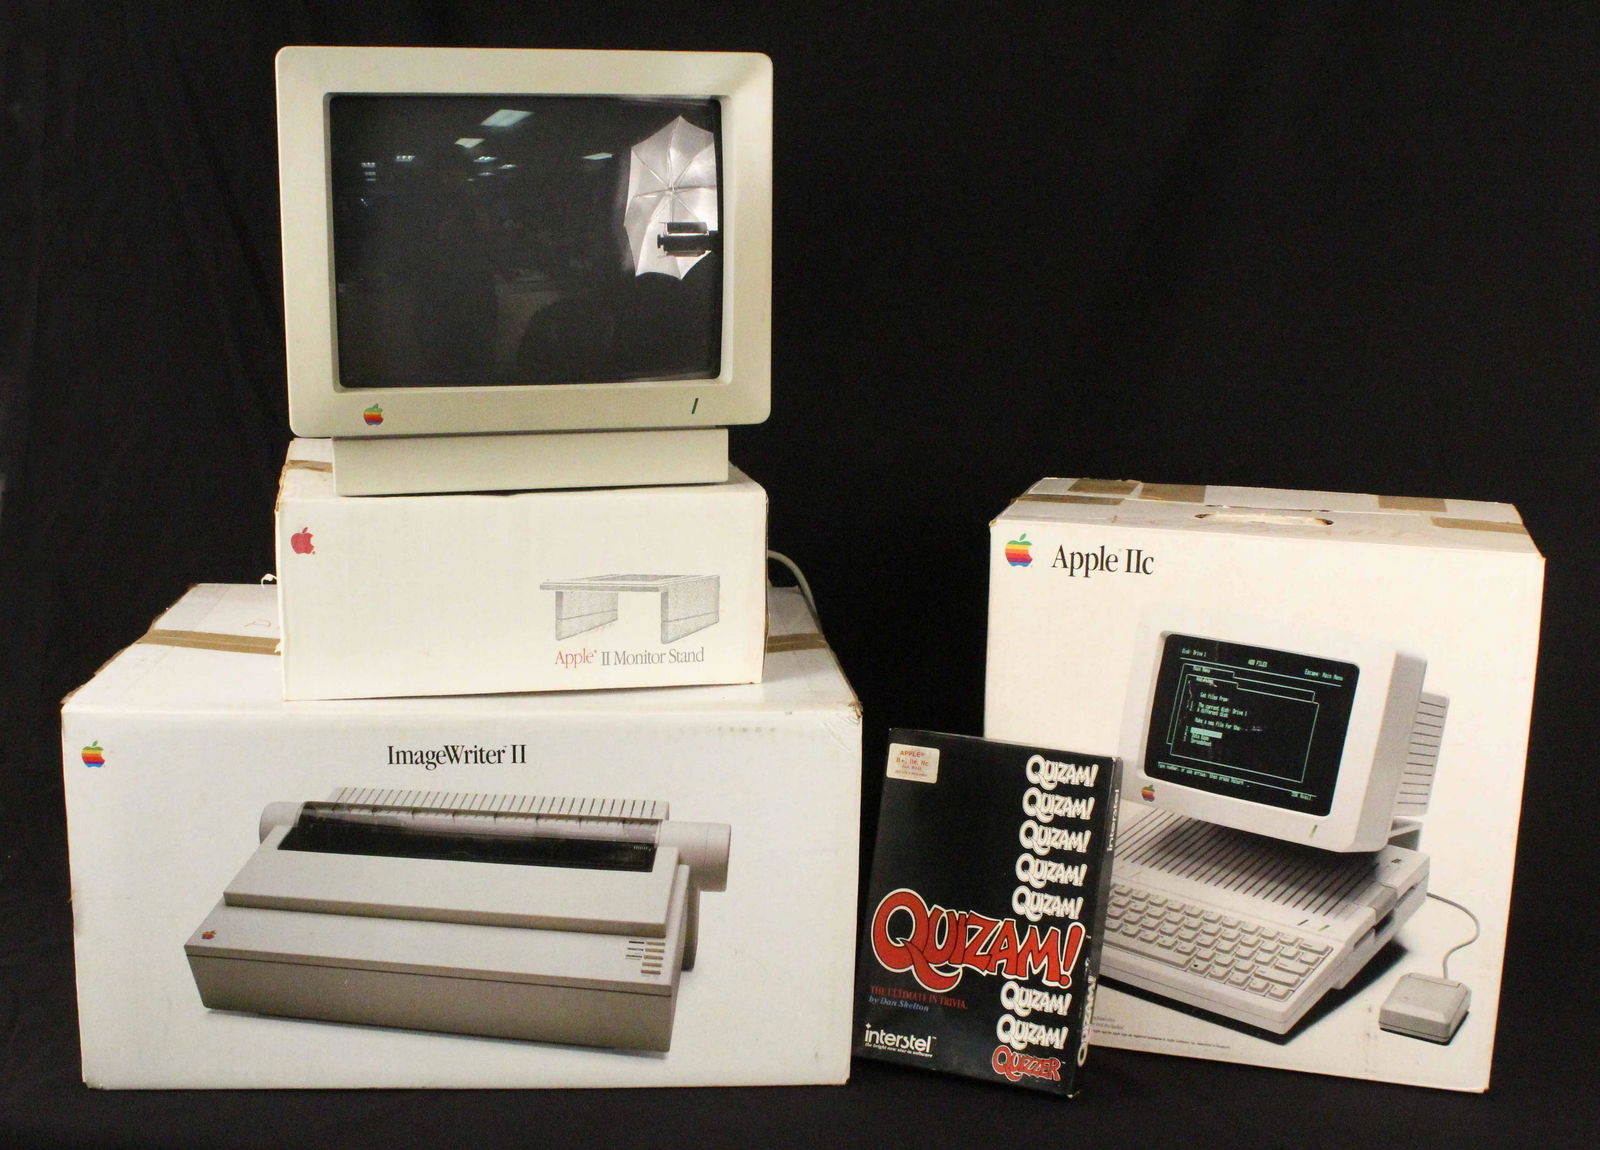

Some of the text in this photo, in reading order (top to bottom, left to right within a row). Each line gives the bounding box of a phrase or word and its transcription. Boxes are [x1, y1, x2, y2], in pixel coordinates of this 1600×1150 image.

[1051, 544, 1154, 578] Apple IIc
[602, 651, 611, 665] II
[614, 649, 666, 666] Monitor
[669, 647, 704, 663] Stand
[387, 744, 526, 771] ImageWriter II
[1025, 754, 1099, 791] QUIZAM!
[1022, 786, 1095, 824] QUIZAM!
[1018, 819, 1092, 856] QUIZAM!
[1015, 852, 1088, 889] QUIZAM!
[1011, 885, 1084, 922] QUIZAM!
[871, 887, 1086, 993] QUIZAM!
[868, 995, 930, 1012] by Dan Skelton
[1000, 980, 1073, 1017] QUIZAM!
[996, 1013, 1069, 1050] QUIZAM!
